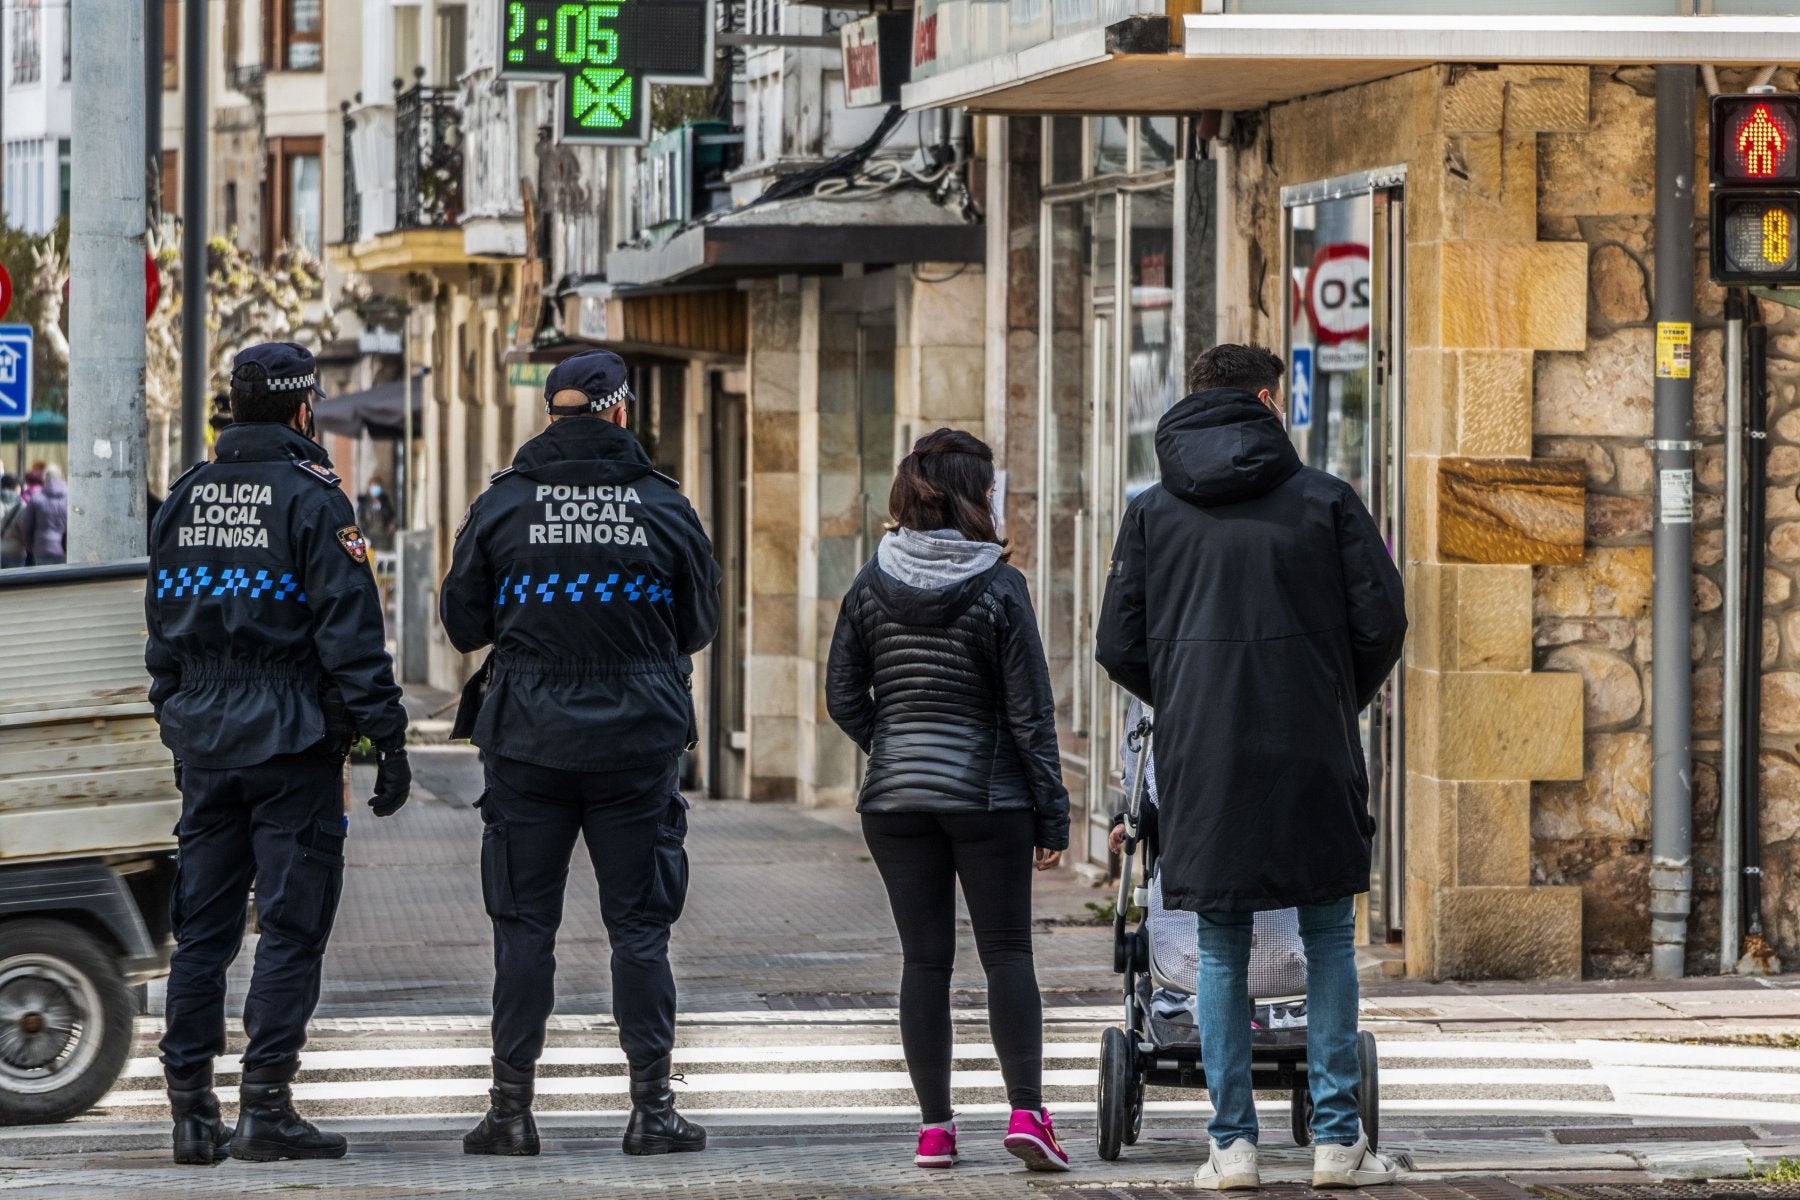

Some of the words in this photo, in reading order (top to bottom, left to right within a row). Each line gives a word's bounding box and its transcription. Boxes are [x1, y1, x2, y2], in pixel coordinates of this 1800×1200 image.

[1763, 208, 1789, 264] 8
[189, 483, 272, 505] POLICIA
[535, 485, 642, 504] POLICIA
[192, 505, 261, 526] LOCAL
[545, 502, 634, 523] LOCAL
[178, 526, 269, 548] REINOSA
[529, 523, 649, 547] REINOSA
